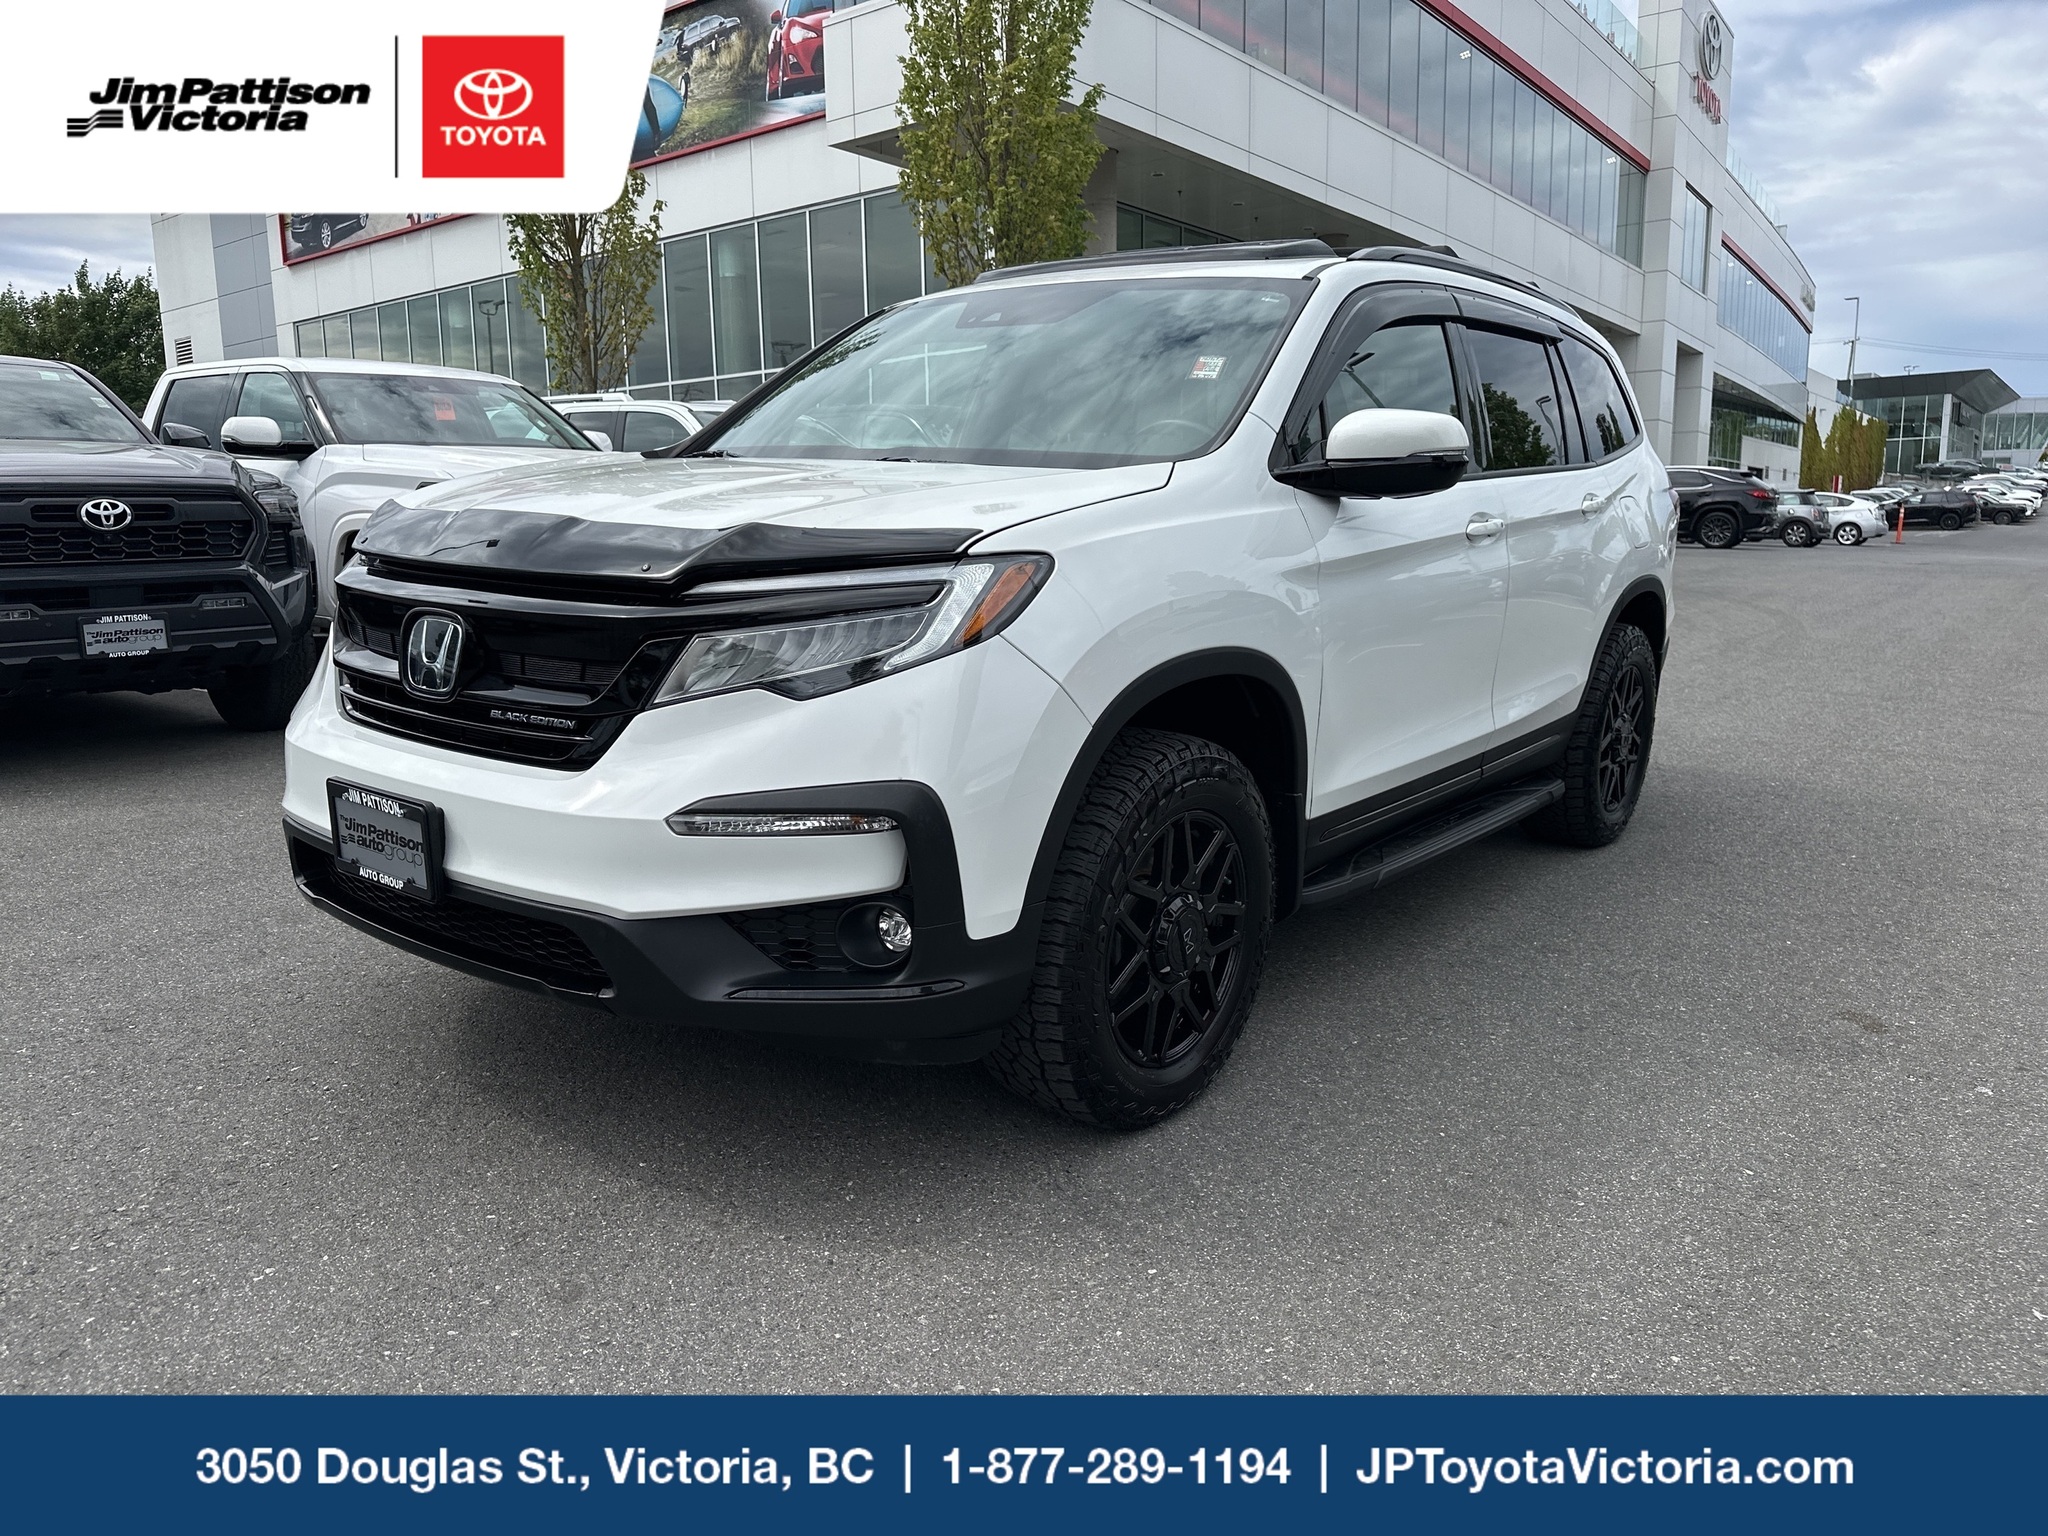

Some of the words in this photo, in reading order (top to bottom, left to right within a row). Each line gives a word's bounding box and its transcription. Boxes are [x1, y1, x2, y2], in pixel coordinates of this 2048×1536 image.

[1692, 71, 1721, 124] TOYOTA
[100, 615, 113, 624] JIM
[114, 614, 148, 622] PATTISON
[490, 710, 528, 722] BLACK
[529, 716, 576, 729] EDITION
[348, 789, 361, 806] JIM
[361, 792, 400, 816] PATTISON
[359, 866, 378, 881] AUTO
[378, 873, 404, 890] GROUP
